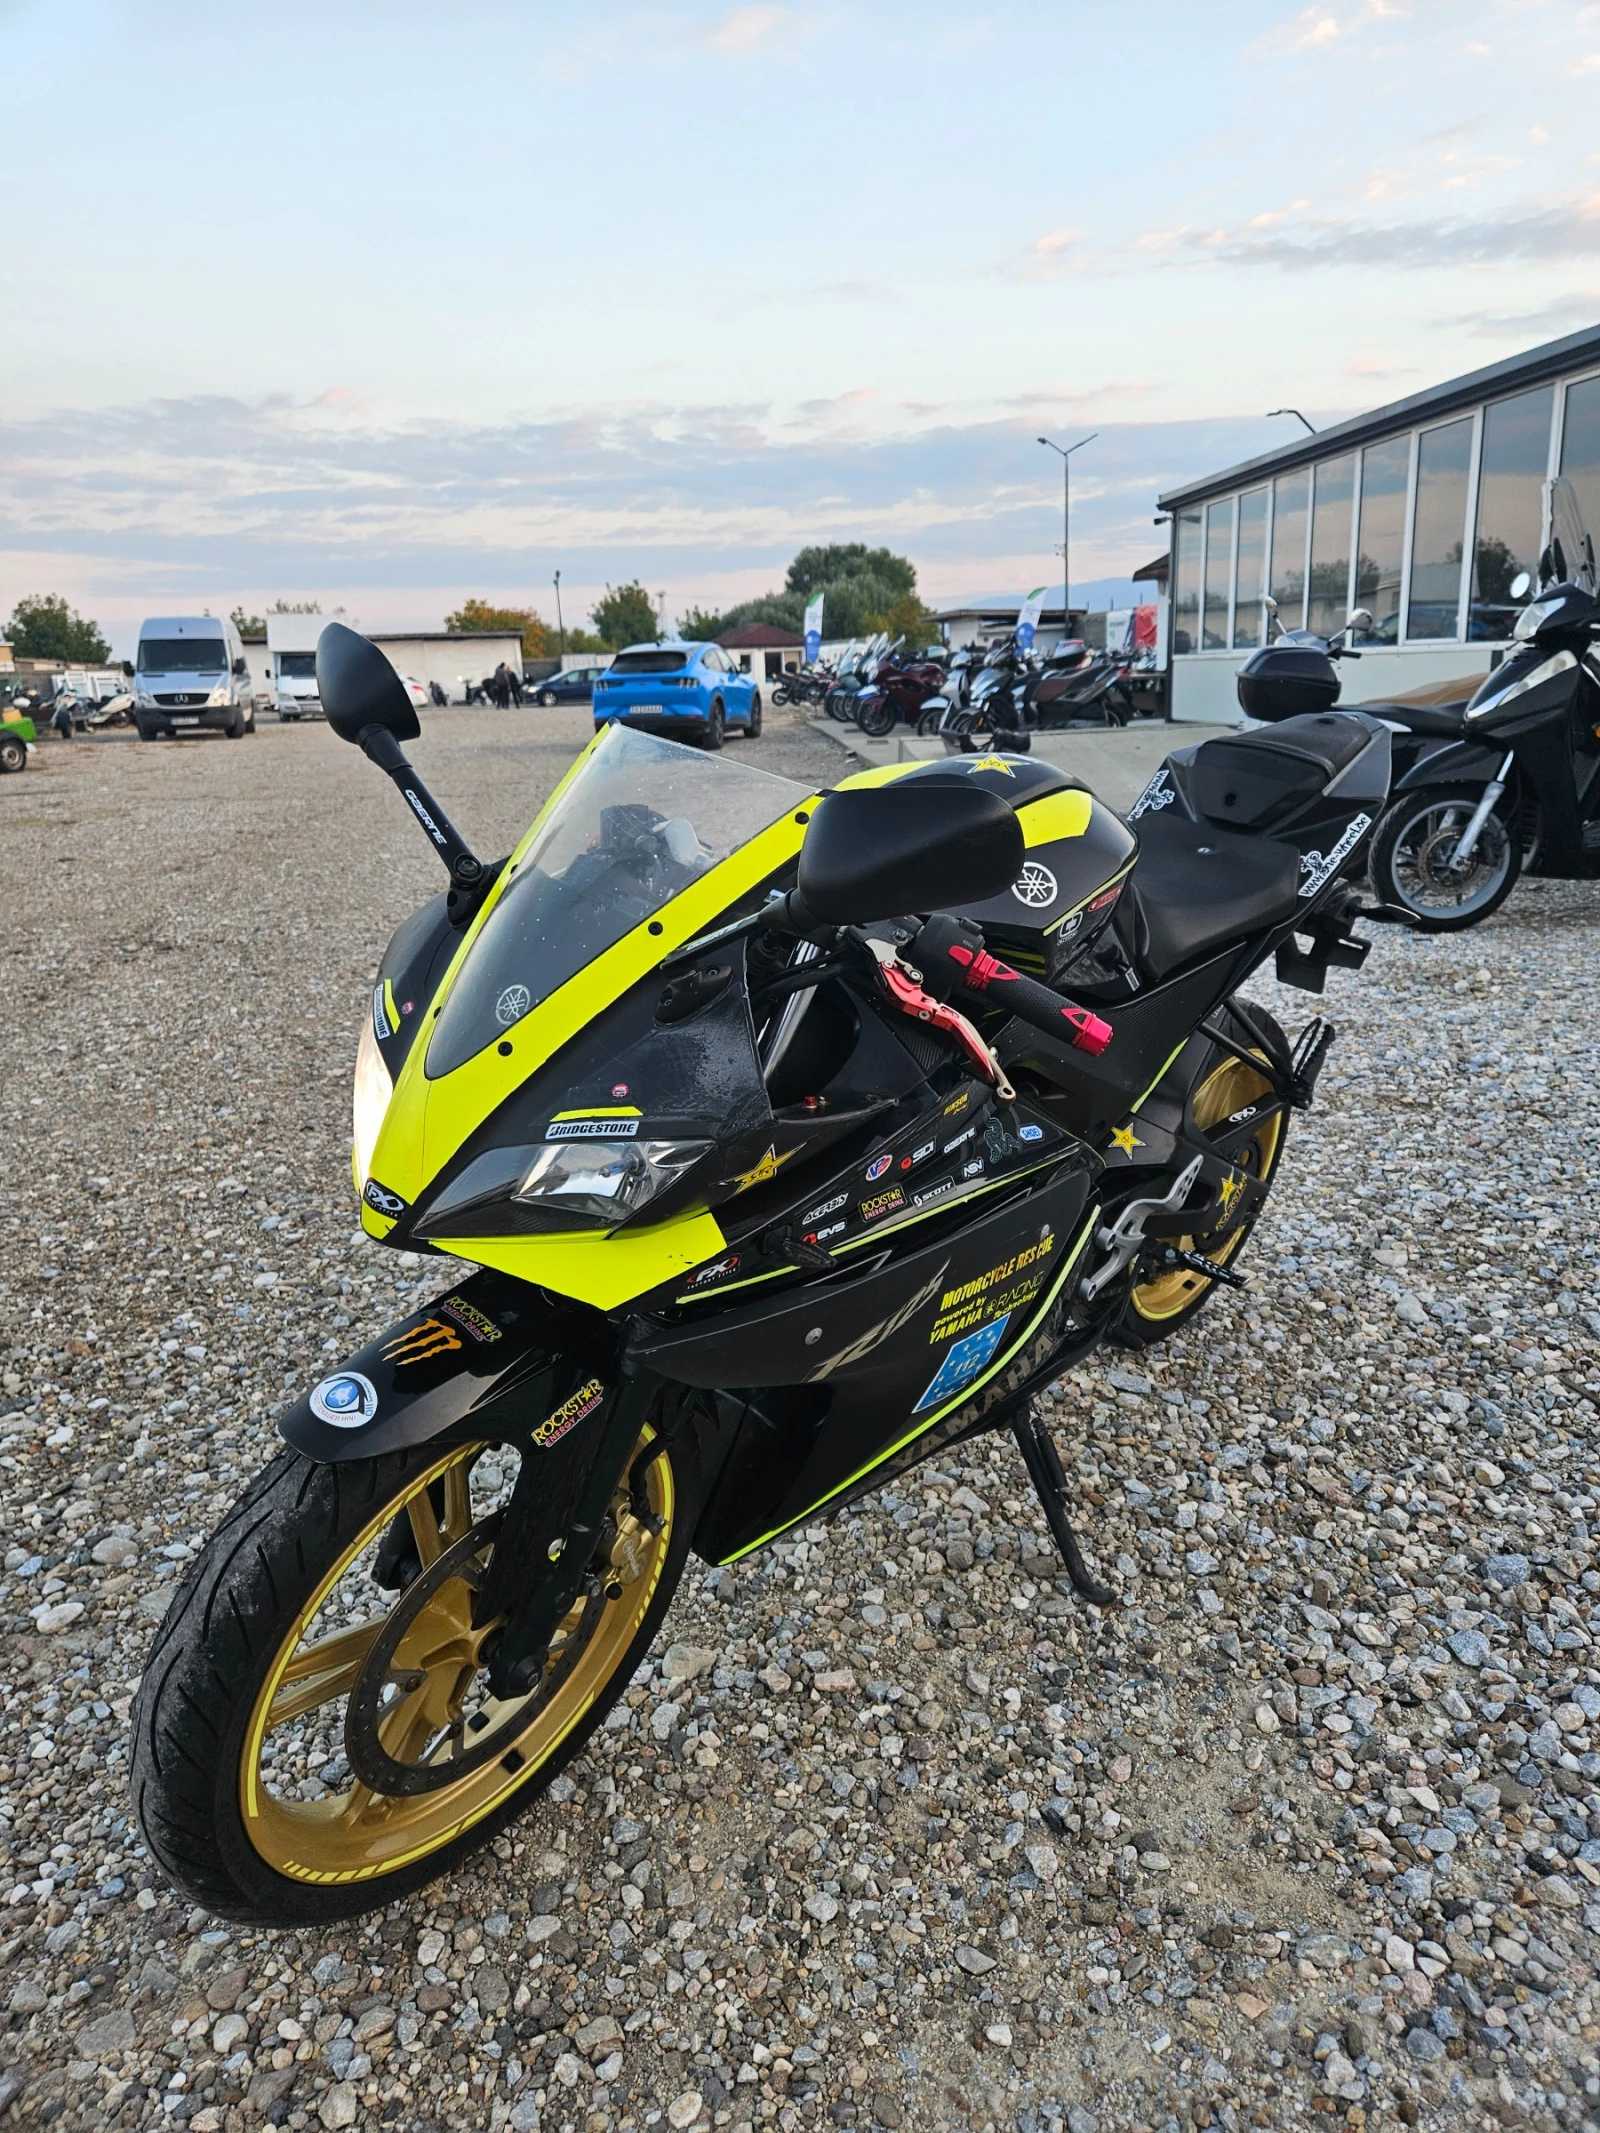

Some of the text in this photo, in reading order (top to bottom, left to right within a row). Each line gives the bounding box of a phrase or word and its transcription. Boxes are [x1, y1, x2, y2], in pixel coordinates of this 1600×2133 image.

[548, 1123, 635, 1137] BRIDGESTONE
[922, 1182, 953, 1201] SCOTT
[864, 1197, 905, 1220] ENERGY DRINK
[816, 1221, 846, 1240] EVS
[940, 1257, 1016, 1312] MOTORCYCLE
[929, 1307, 983, 1345] YAMAHA
[933, 1295, 988, 1330] powered by
[953, 1353, 981, 1377] 112
[888, 1332, 1054, 1468] YAMAHA
[545, 1395, 601, 1446] ENERGY DRINK
